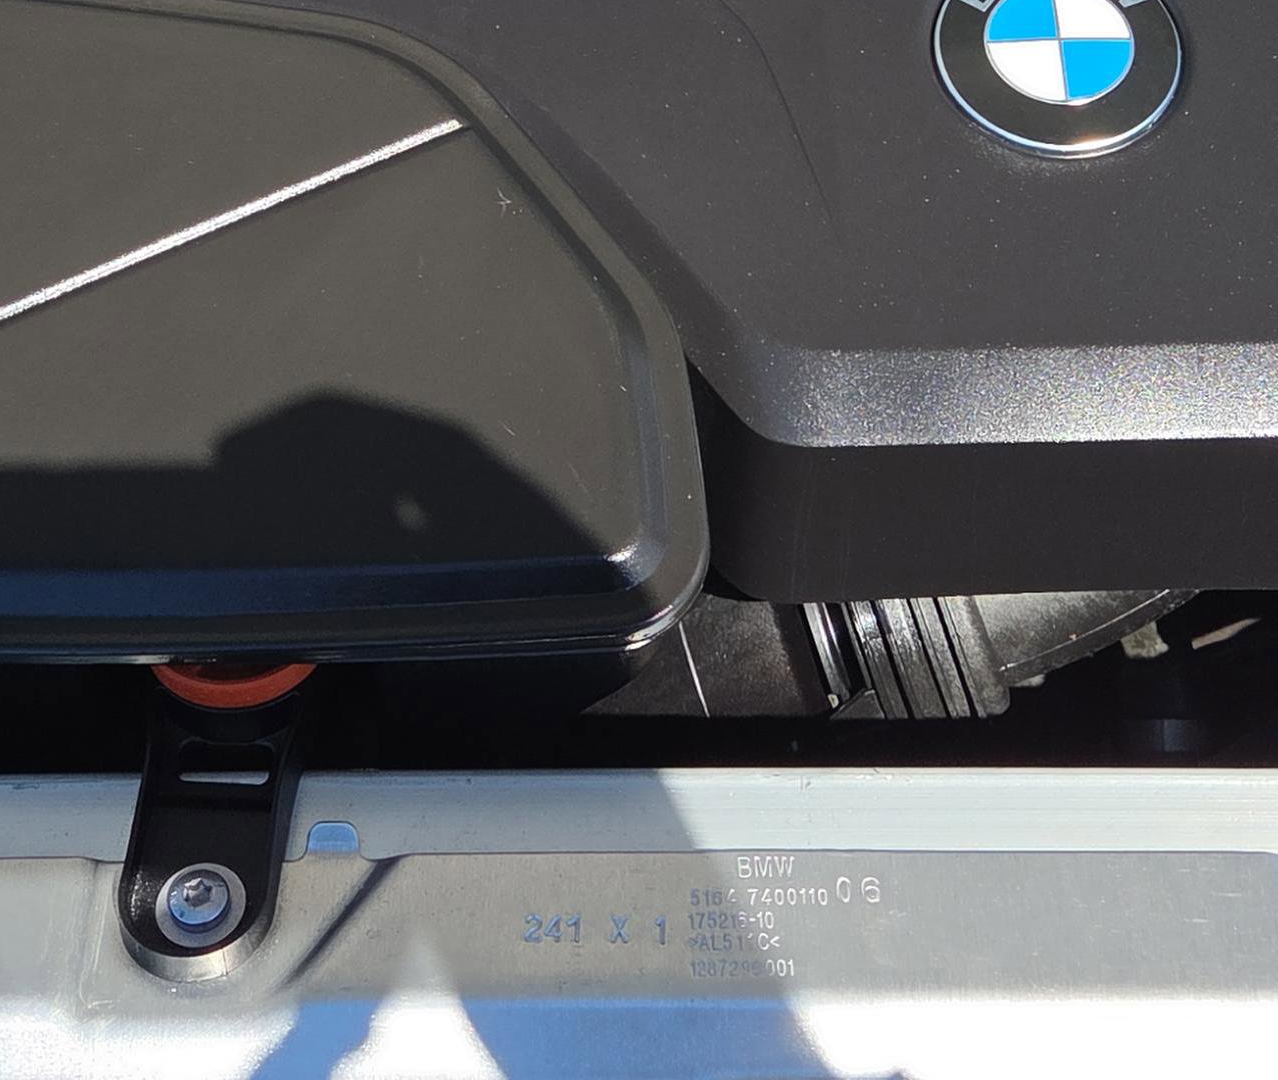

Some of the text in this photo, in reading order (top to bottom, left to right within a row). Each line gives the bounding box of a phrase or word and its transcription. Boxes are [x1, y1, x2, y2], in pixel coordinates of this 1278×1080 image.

[737, 856, 795, 879] BMW
[747, 888, 828, 906] 7400110
[524, 913, 581, 943] 241
